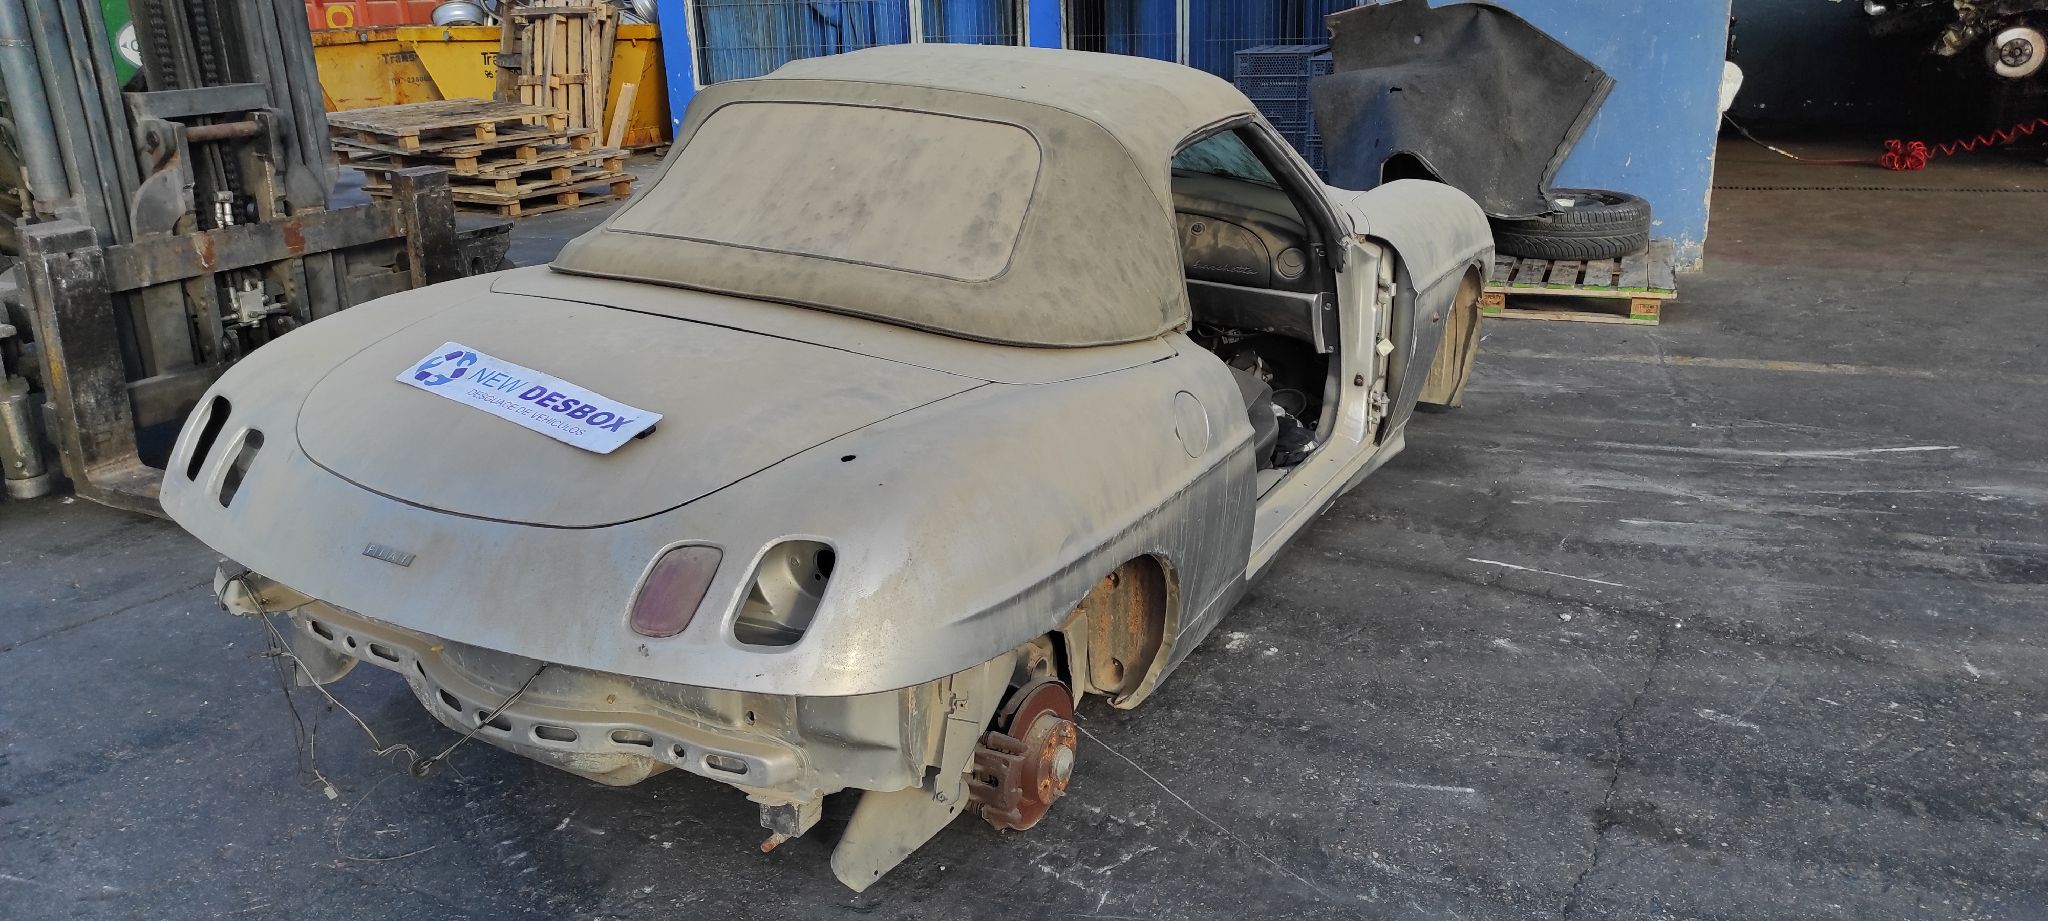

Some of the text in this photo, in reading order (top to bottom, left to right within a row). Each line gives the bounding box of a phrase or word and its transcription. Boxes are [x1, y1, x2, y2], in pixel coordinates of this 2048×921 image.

[467, 367, 634, 433] NEW DESBOX
[515, 406, 533, 416] DE
[530, 411, 587, 436] VEHICULOS
[366, 543, 409, 564] FIAT
